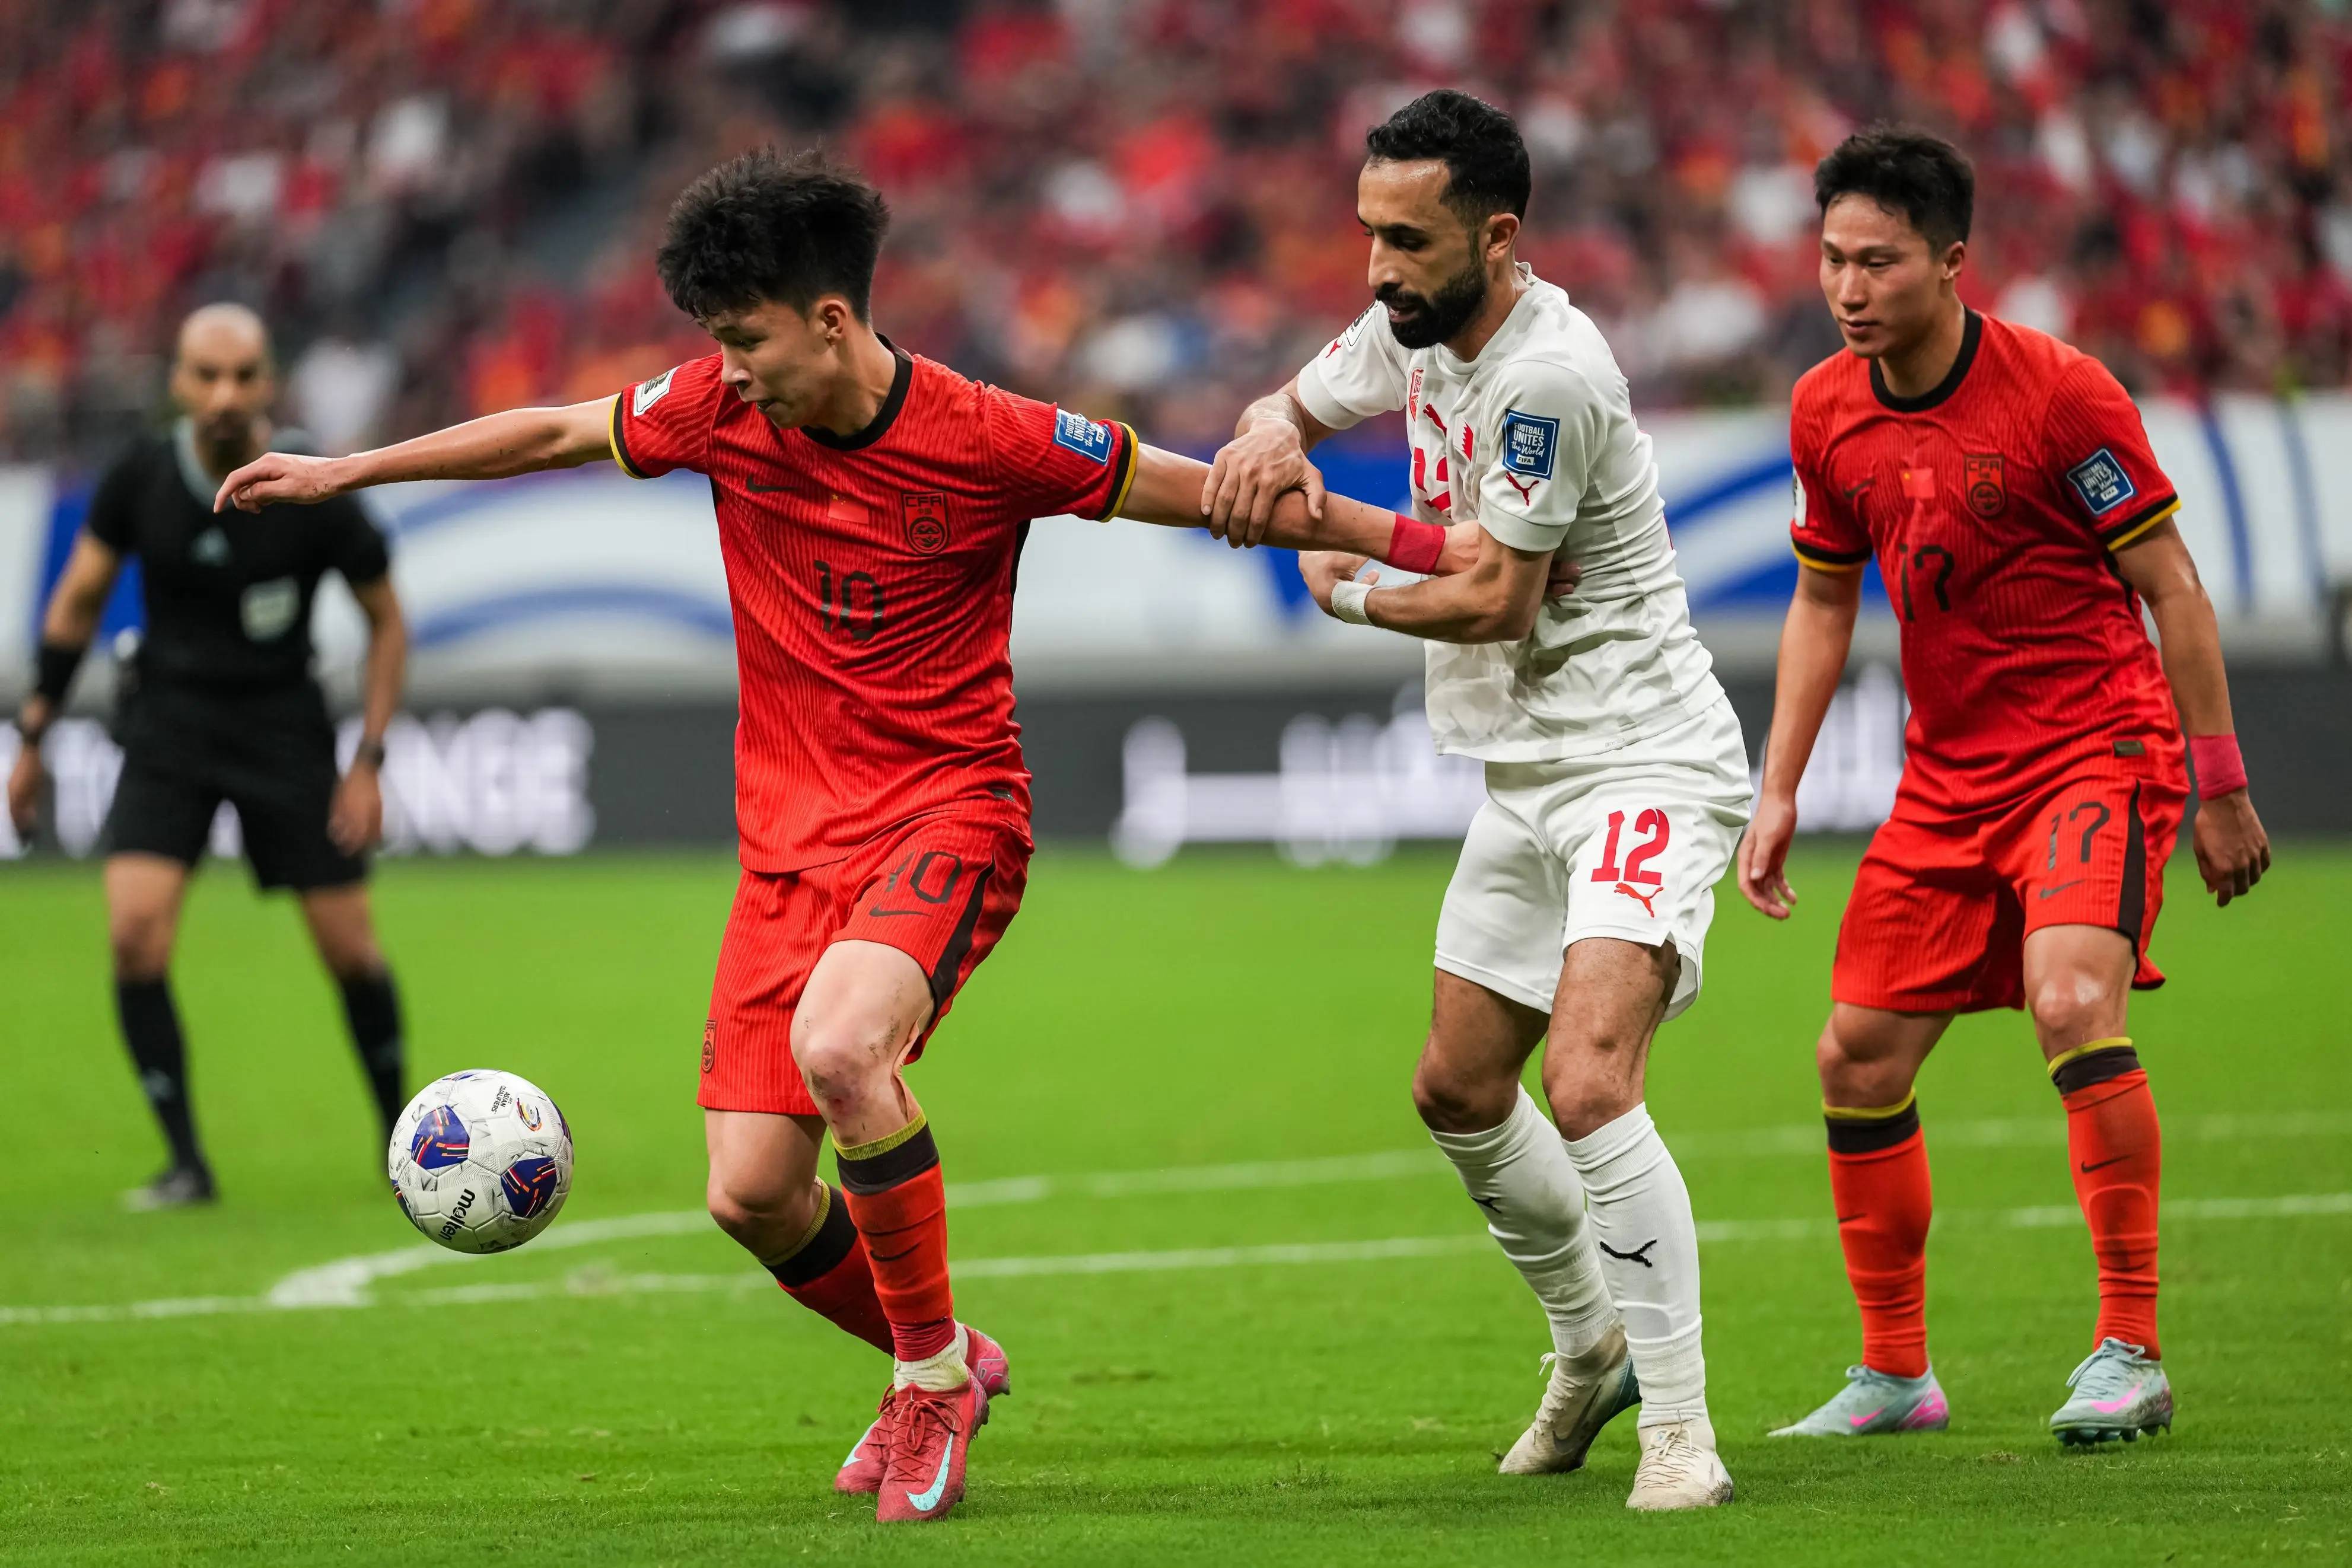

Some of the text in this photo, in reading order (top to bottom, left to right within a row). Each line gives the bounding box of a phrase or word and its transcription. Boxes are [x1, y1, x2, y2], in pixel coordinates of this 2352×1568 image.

[1073, 416, 1087, 442] UNITE
[1513, 429, 1544, 447] UNITES
[1514, 422, 1545, 436] FOOTBALL
[1511, 440, 1545, 458] the World
[905, 496, 942, 507] CFA
[1898, 543, 1955, 621] 17
[814, 560, 883, 641] 10
[1590, 808, 1670, 885] 12
[2048, 801, 2111, 871] 17
[886, 850, 962, 904] 10
[491, 1085, 507, 1112] QUALIFIERS
[500, 1091, 511, 1108] ASIAN
[438, 1188, 476, 1240] molten
